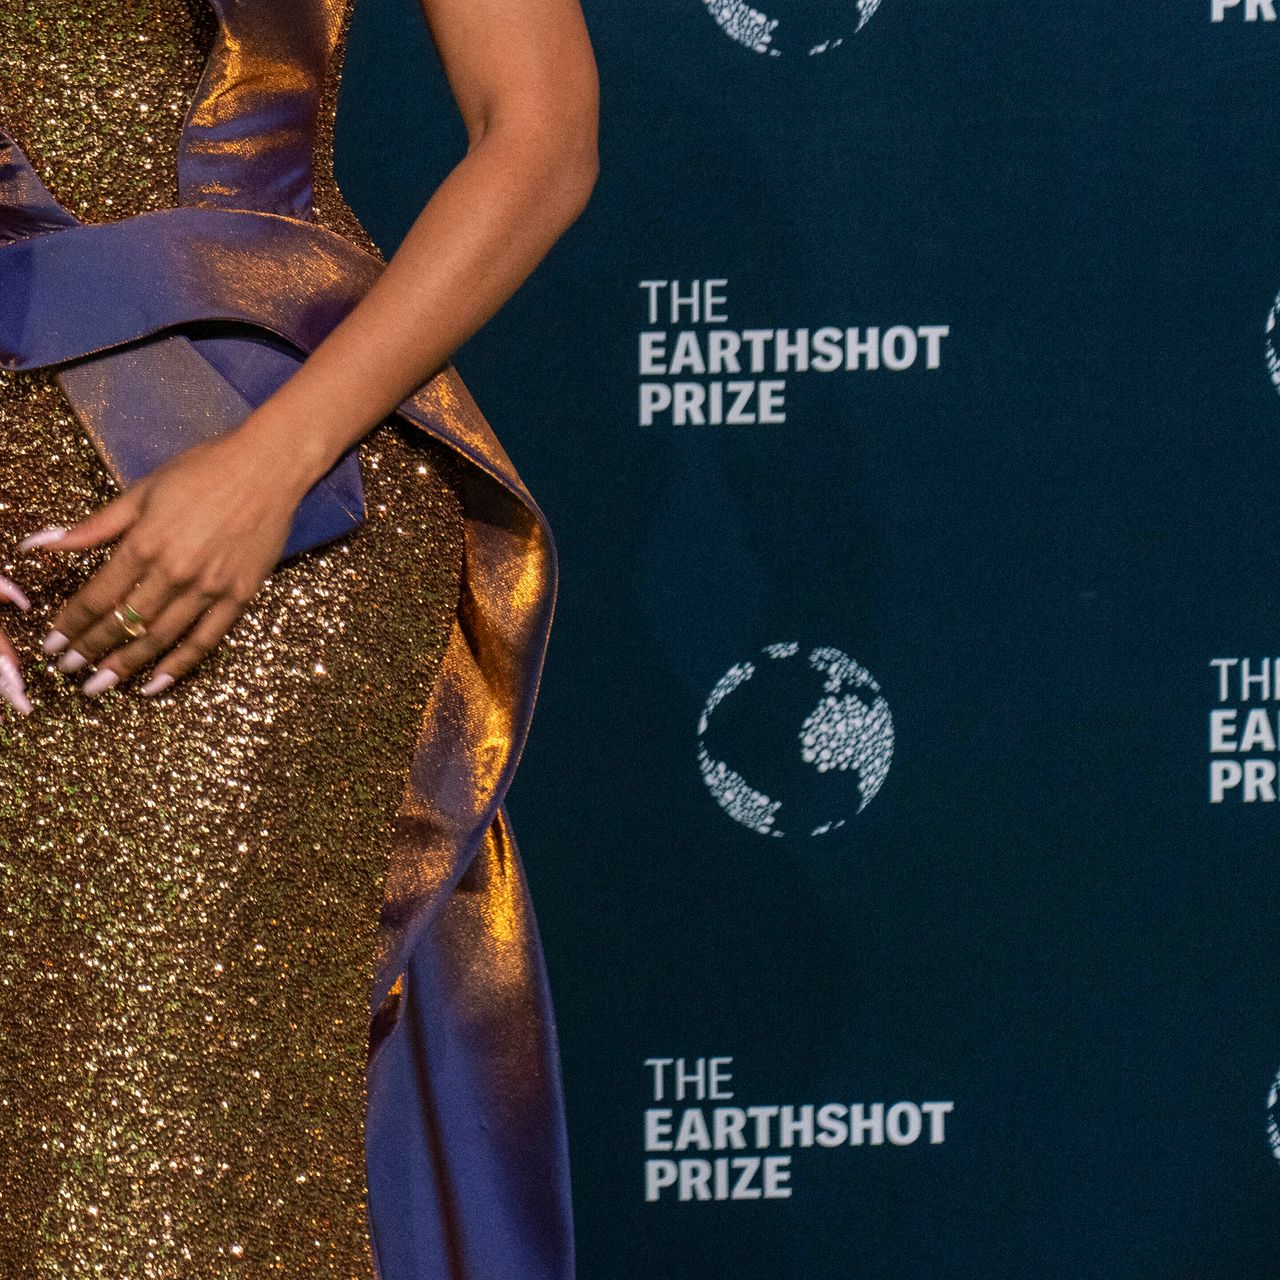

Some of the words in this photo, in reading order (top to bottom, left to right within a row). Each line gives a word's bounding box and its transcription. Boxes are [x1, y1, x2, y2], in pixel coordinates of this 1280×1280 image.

[639, 279, 728, 323] THE
[640, 325, 949, 374] EARTHSHOT
[640, 380, 786, 426] PRIZE
[645, 1057, 733, 1101] THE
[646, 1102, 953, 1151] EARTHSHOT
[646, 1156, 792, 1201] PRIZE
